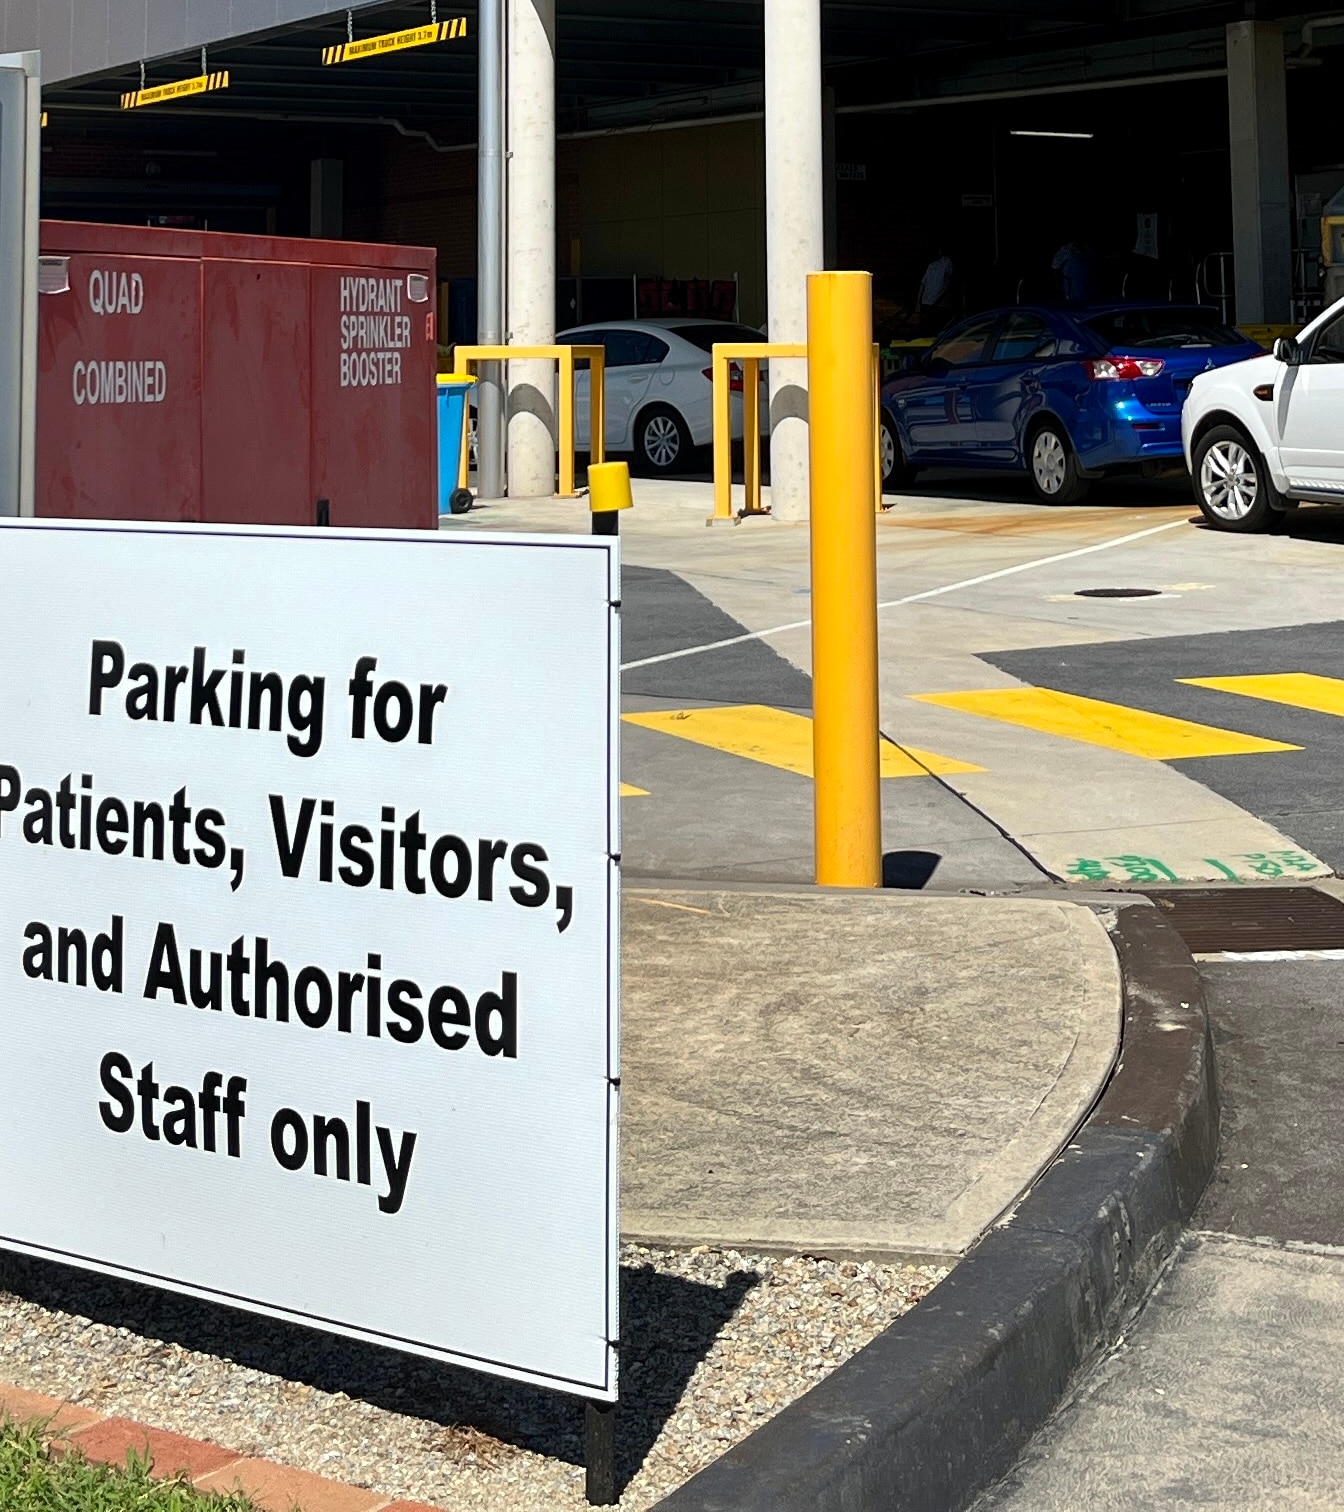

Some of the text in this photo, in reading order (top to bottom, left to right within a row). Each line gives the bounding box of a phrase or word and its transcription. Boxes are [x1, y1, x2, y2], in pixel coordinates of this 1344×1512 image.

[349, 42, 377, 55] MAXIMUM
[378, 38, 395, 49] TRUCK
[397, 34, 416, 45] HEIGHT
[88, 270, 144, 315] QUAD
[340, 277, 403, 312] HYDRANT
[340, 315, 411, 349] SPRINKLER
[72, 360, 166, 405] COMBINED
[340, 352, 401, 386] BOOSTER
[88, 638, 448, 757] Parking for
[268, 793, 575, 932] Visitors,
[22, 914, 519, 1058] and Authorised
[98, 1050, 416, 1216] Staff only
